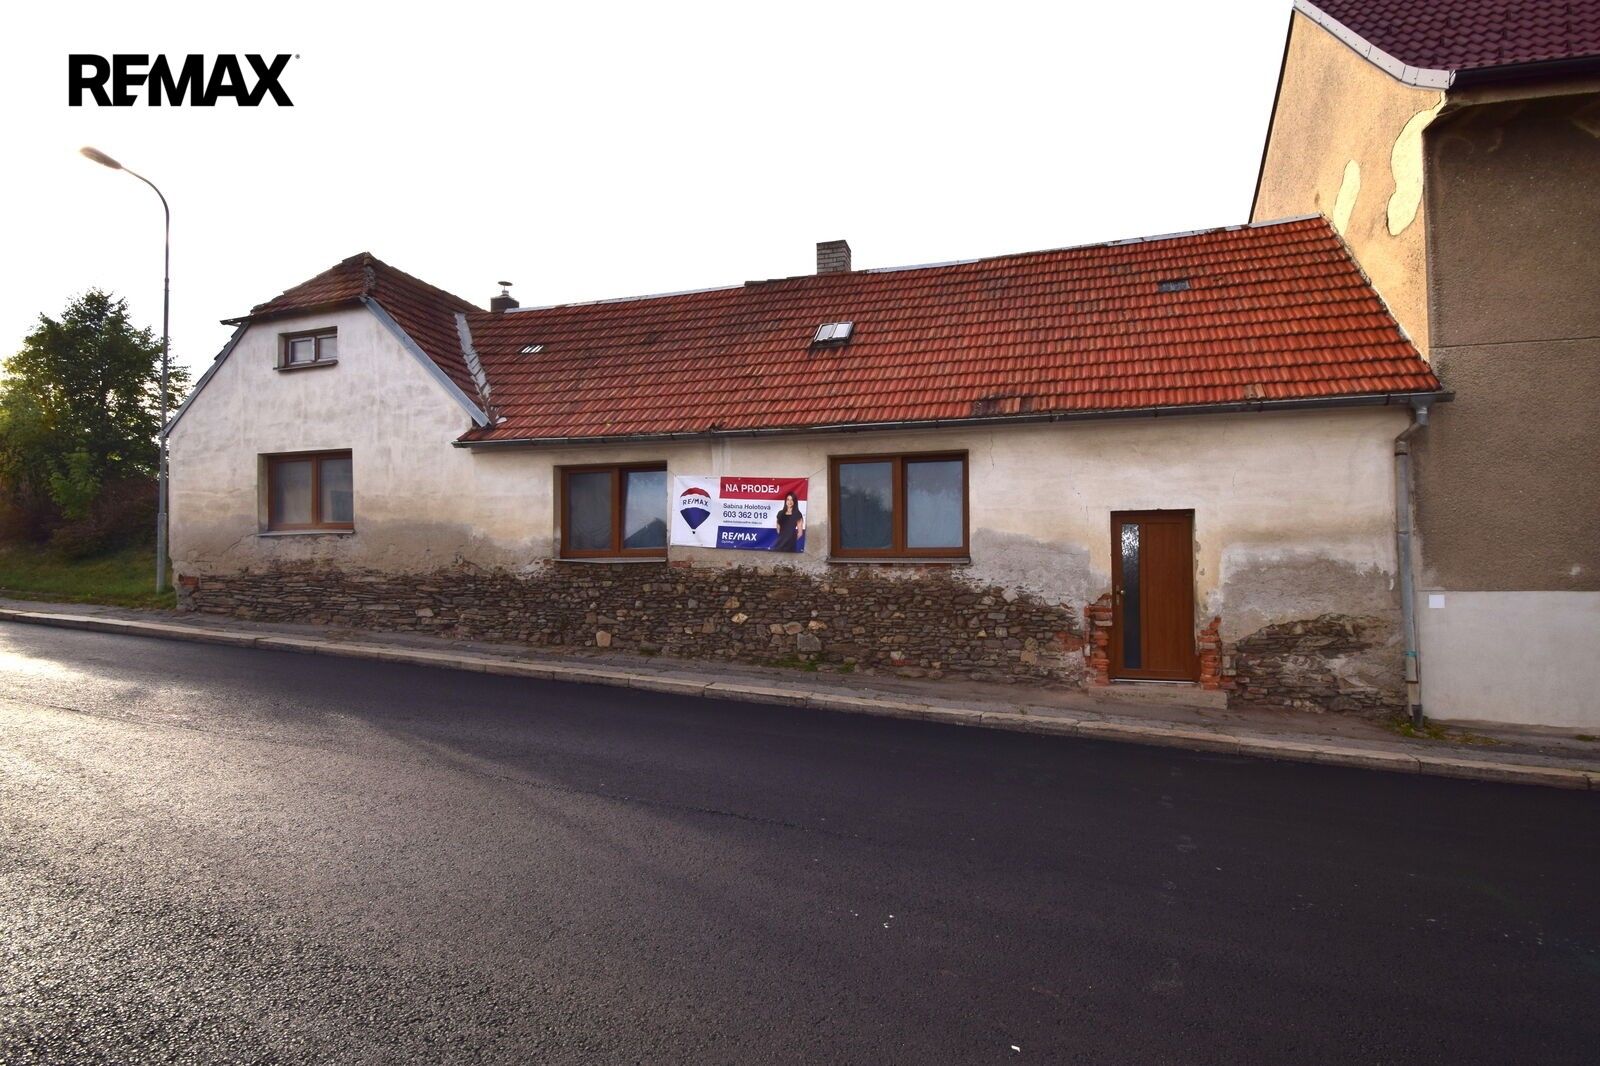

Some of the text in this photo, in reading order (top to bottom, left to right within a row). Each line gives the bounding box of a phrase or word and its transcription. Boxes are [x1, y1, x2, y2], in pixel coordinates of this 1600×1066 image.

[725, 484, 780, 493] NA PRODEJ
[682, 498, 709, 507] RE/MAX
[738, 511, 752, 519] 362
[721, 532, 758, 541] RE/MAX
